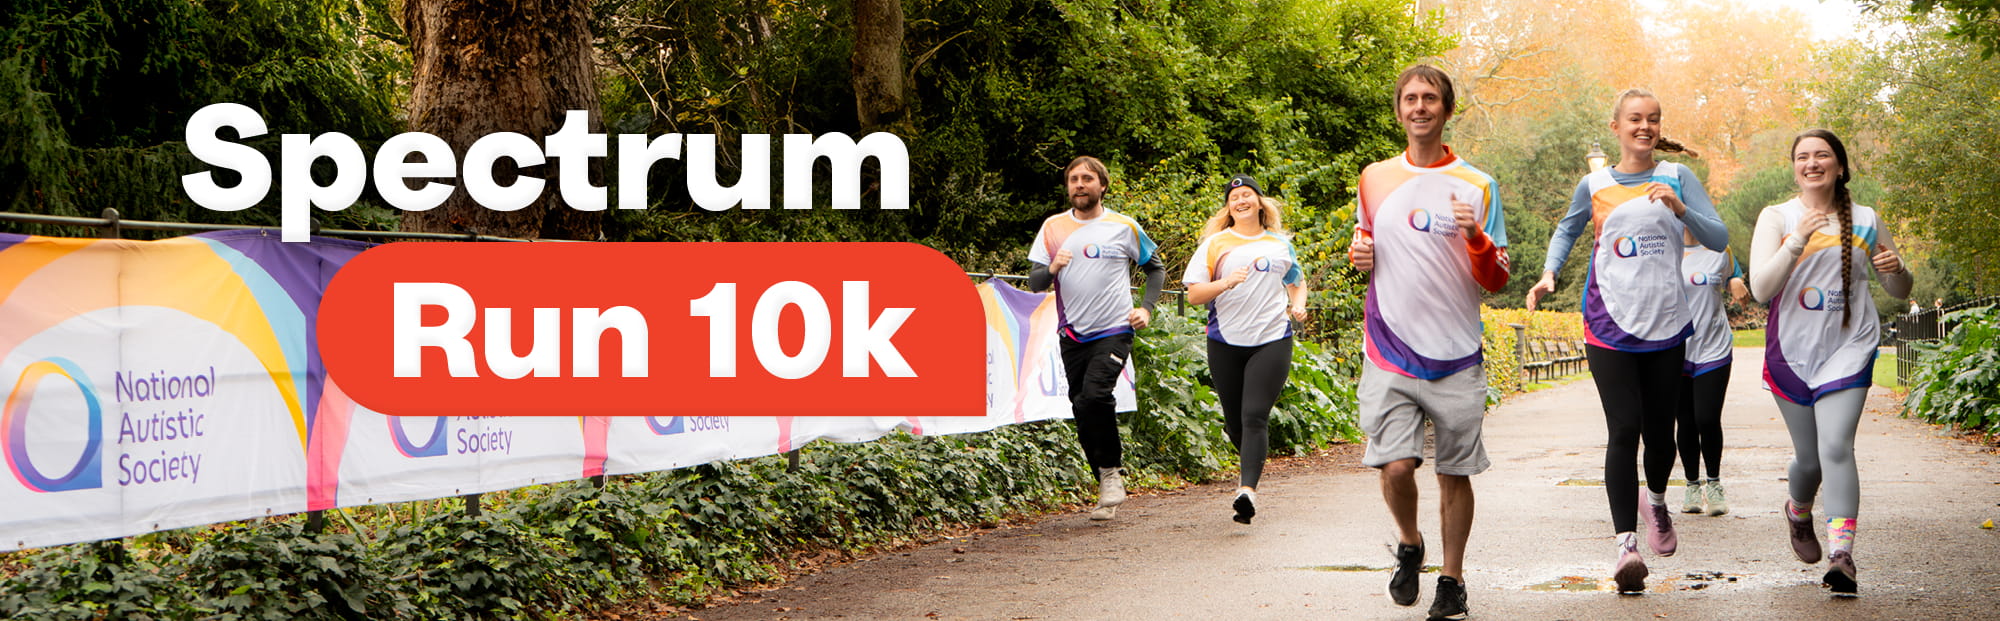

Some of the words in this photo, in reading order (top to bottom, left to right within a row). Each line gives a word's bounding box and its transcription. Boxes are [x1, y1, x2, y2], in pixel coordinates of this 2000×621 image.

[1640, 241, 1665, 249] Autistic
[1640, 248, 1665, 257] Society
[115, 366, 215, 402] National
[117, 408, 204, 444] Autistic
[457, 426, 513, 455] Society
[118, 449, 201, 486] Society
